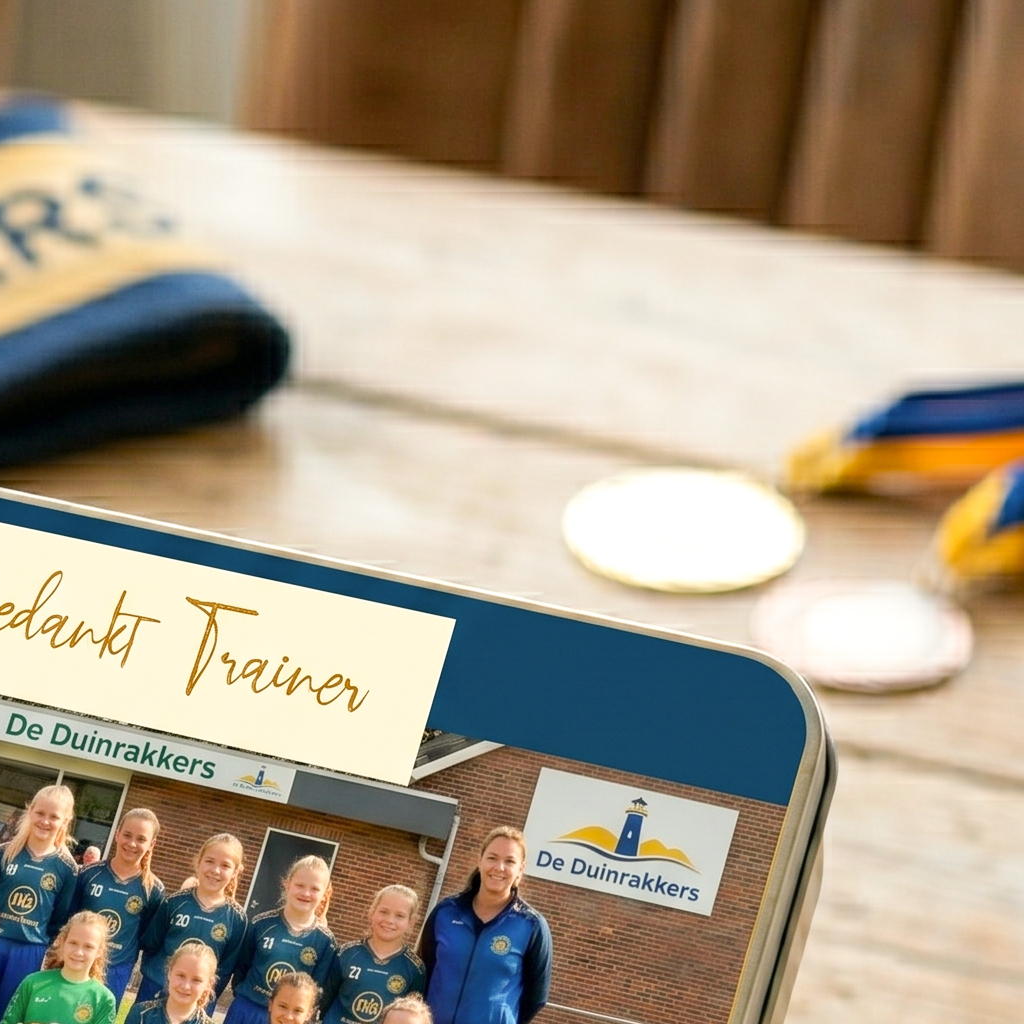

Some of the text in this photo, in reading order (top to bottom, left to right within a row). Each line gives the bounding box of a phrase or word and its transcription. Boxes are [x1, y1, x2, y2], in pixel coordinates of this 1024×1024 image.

[185, 596, 370, 714] Trainer
[5, 712, 44, 741] De
[49, 721, 217, 780] Duinrakkers
[536, 849, 700, 902] De Duinrakkers
